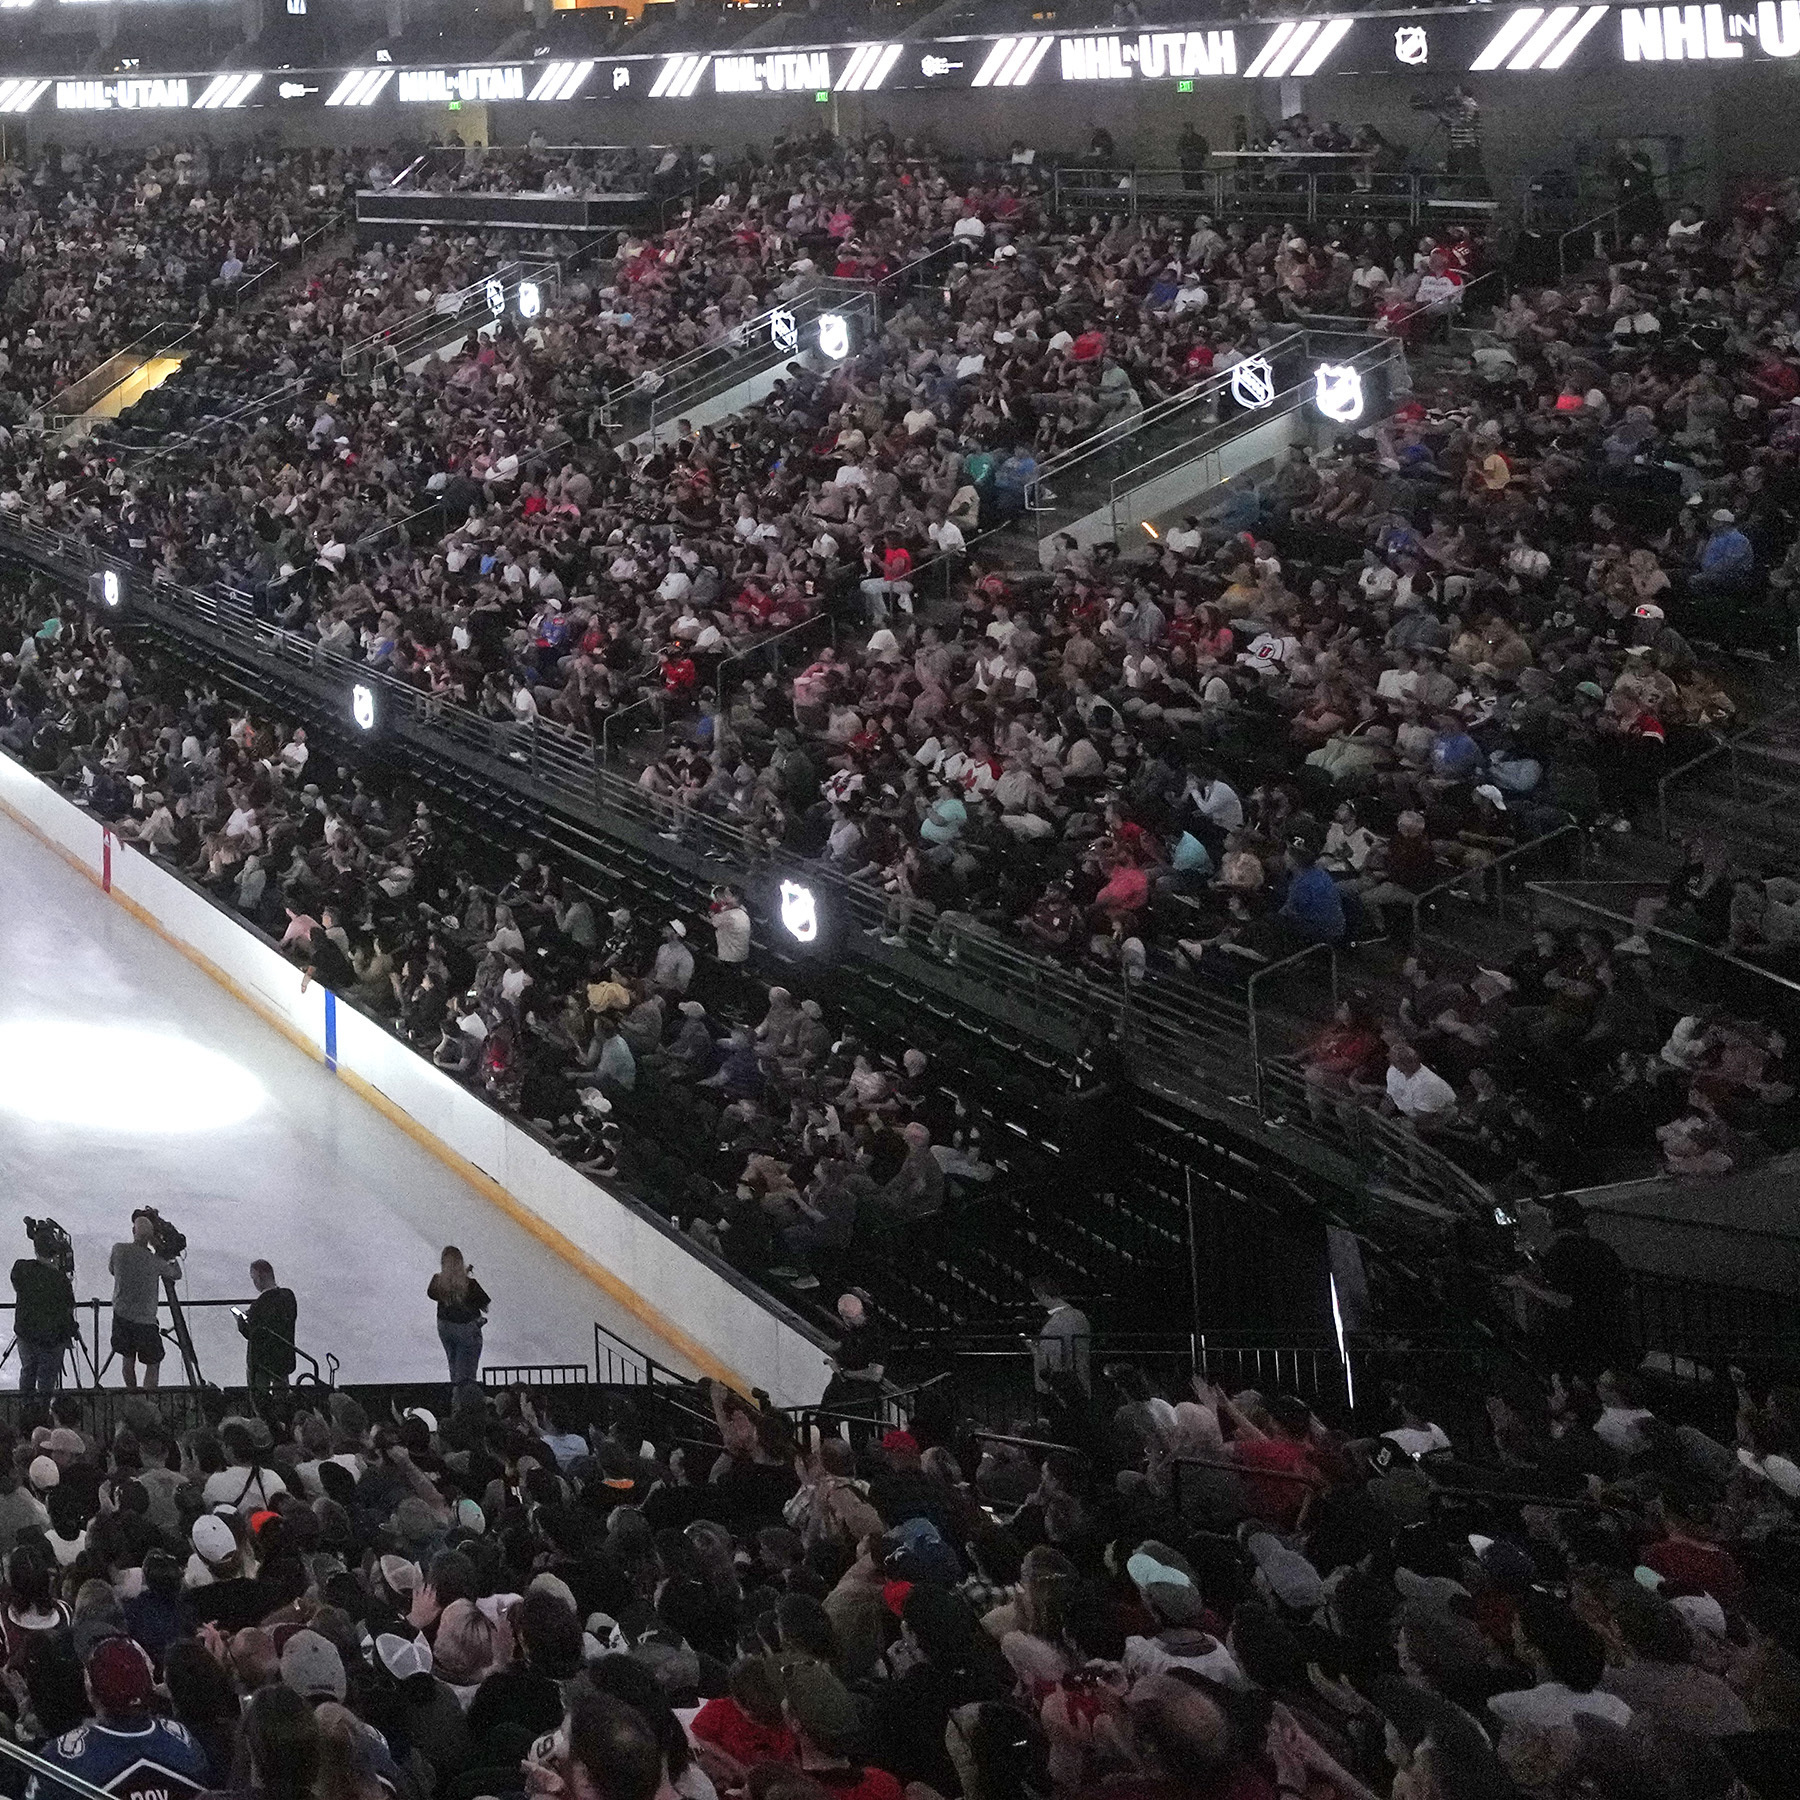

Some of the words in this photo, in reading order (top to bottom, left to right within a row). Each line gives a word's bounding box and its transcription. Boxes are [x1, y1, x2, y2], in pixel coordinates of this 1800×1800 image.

[1622, 4, 1743, 61] NHL
[1729, 14, 1756, 36] IN
[766, 53, 830, 91] UTAH
[1061, 37, 1132, 80] NHL
[1123, 45, 1139, 62] IN
[1138, 31, 1237, 79] UTAH
[117, 79, 188, 108] UTAH
[458, 68, 523, 101] UTAH
